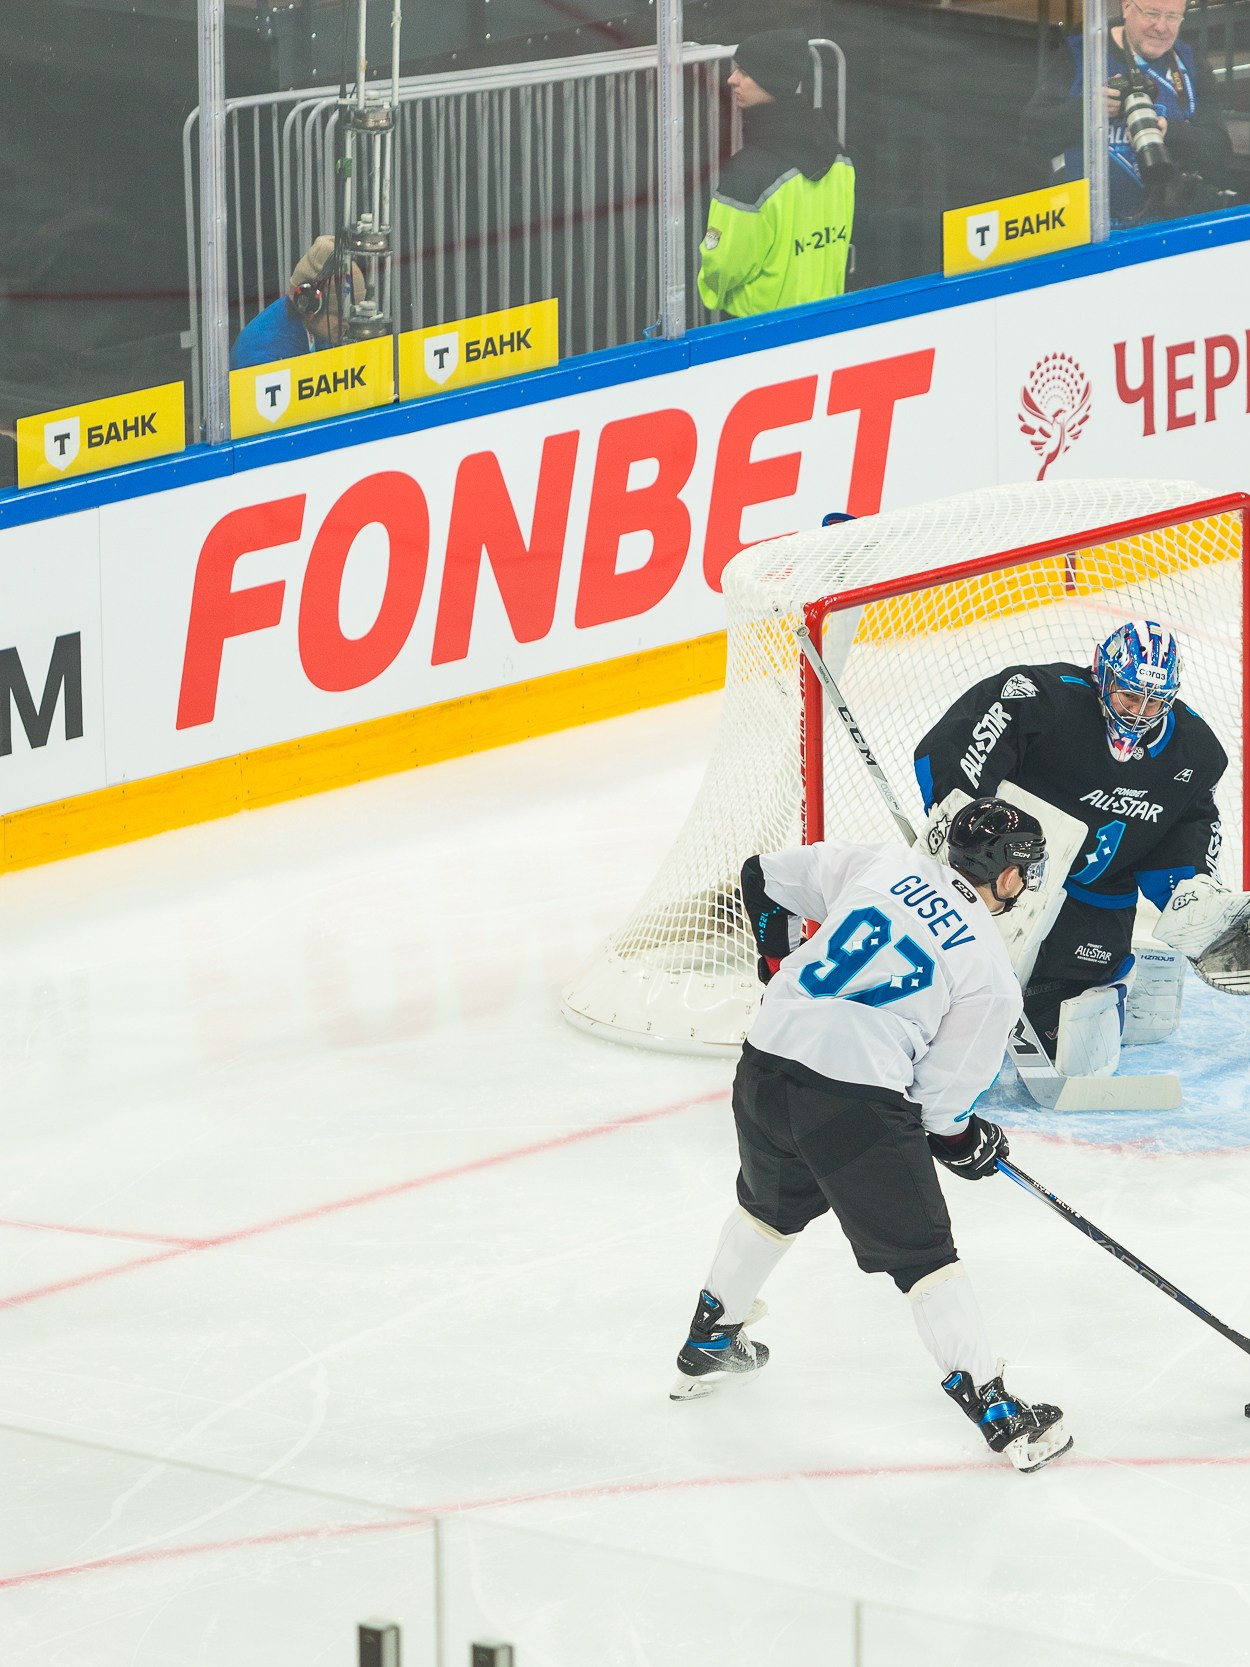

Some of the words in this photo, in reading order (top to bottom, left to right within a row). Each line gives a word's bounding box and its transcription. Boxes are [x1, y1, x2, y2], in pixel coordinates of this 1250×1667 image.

[1005, 208, 1066, 241] БАНК
[465, 327, 532, 363] БАНК
[297, 364, 367, 400] БАНК
[87, 411, 158, 449] БАНК
[176, 347, 936, 731] FONBET
[838, 704, 879, 766] CCM
[1112, 786, 1149, 799] FONBET
[1012, 851, 1031, 859] CCM
[889, 875, 976, 951] GUSEV
[798, 905, 936, 1008] 97
